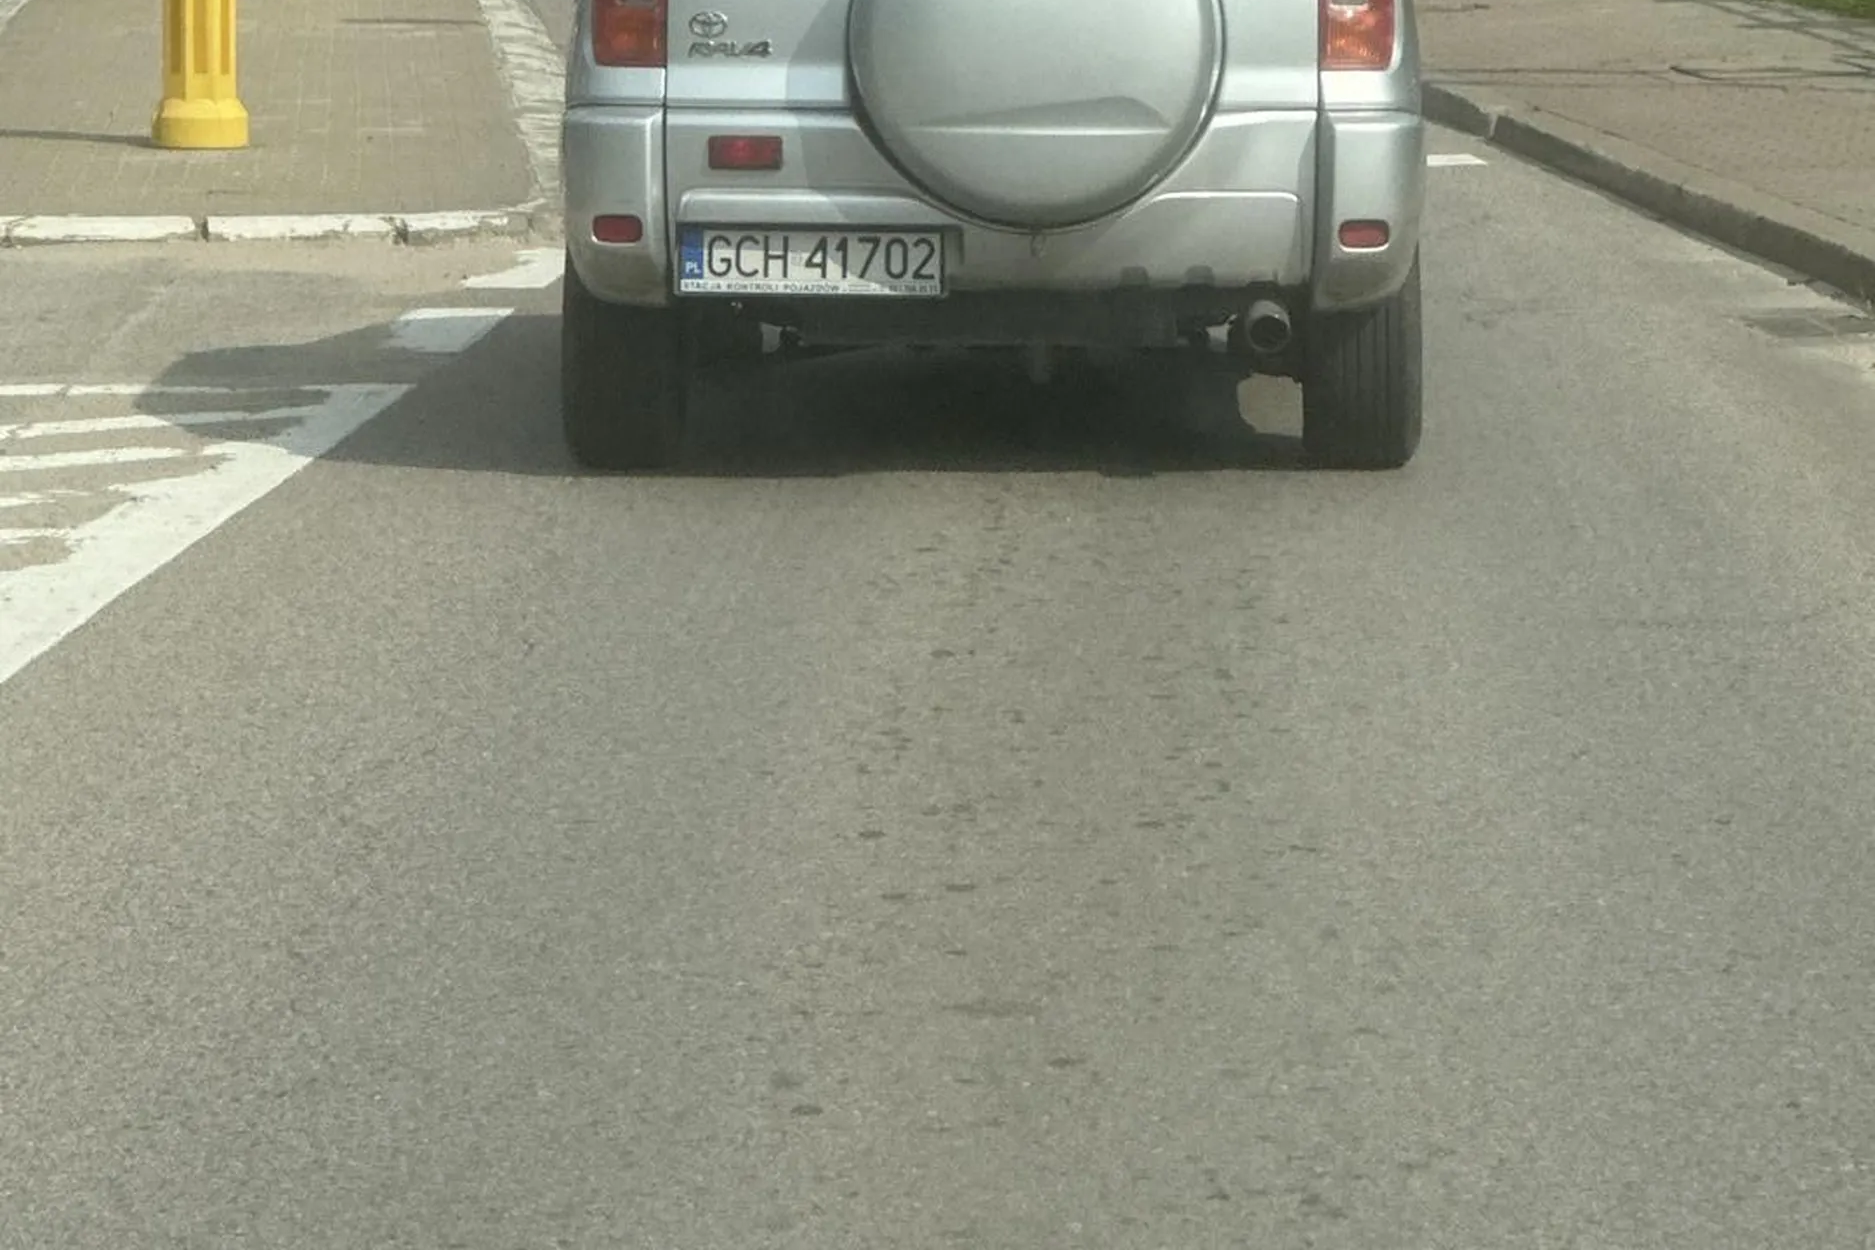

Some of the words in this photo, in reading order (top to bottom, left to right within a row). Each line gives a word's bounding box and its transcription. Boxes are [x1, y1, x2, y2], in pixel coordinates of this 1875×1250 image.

[688, 41, 771, 58] RAV4
[707, 235, 790, 278] GCH
[804, 236, 936, 280] 41702
[685, 261, 701, 274] PL
